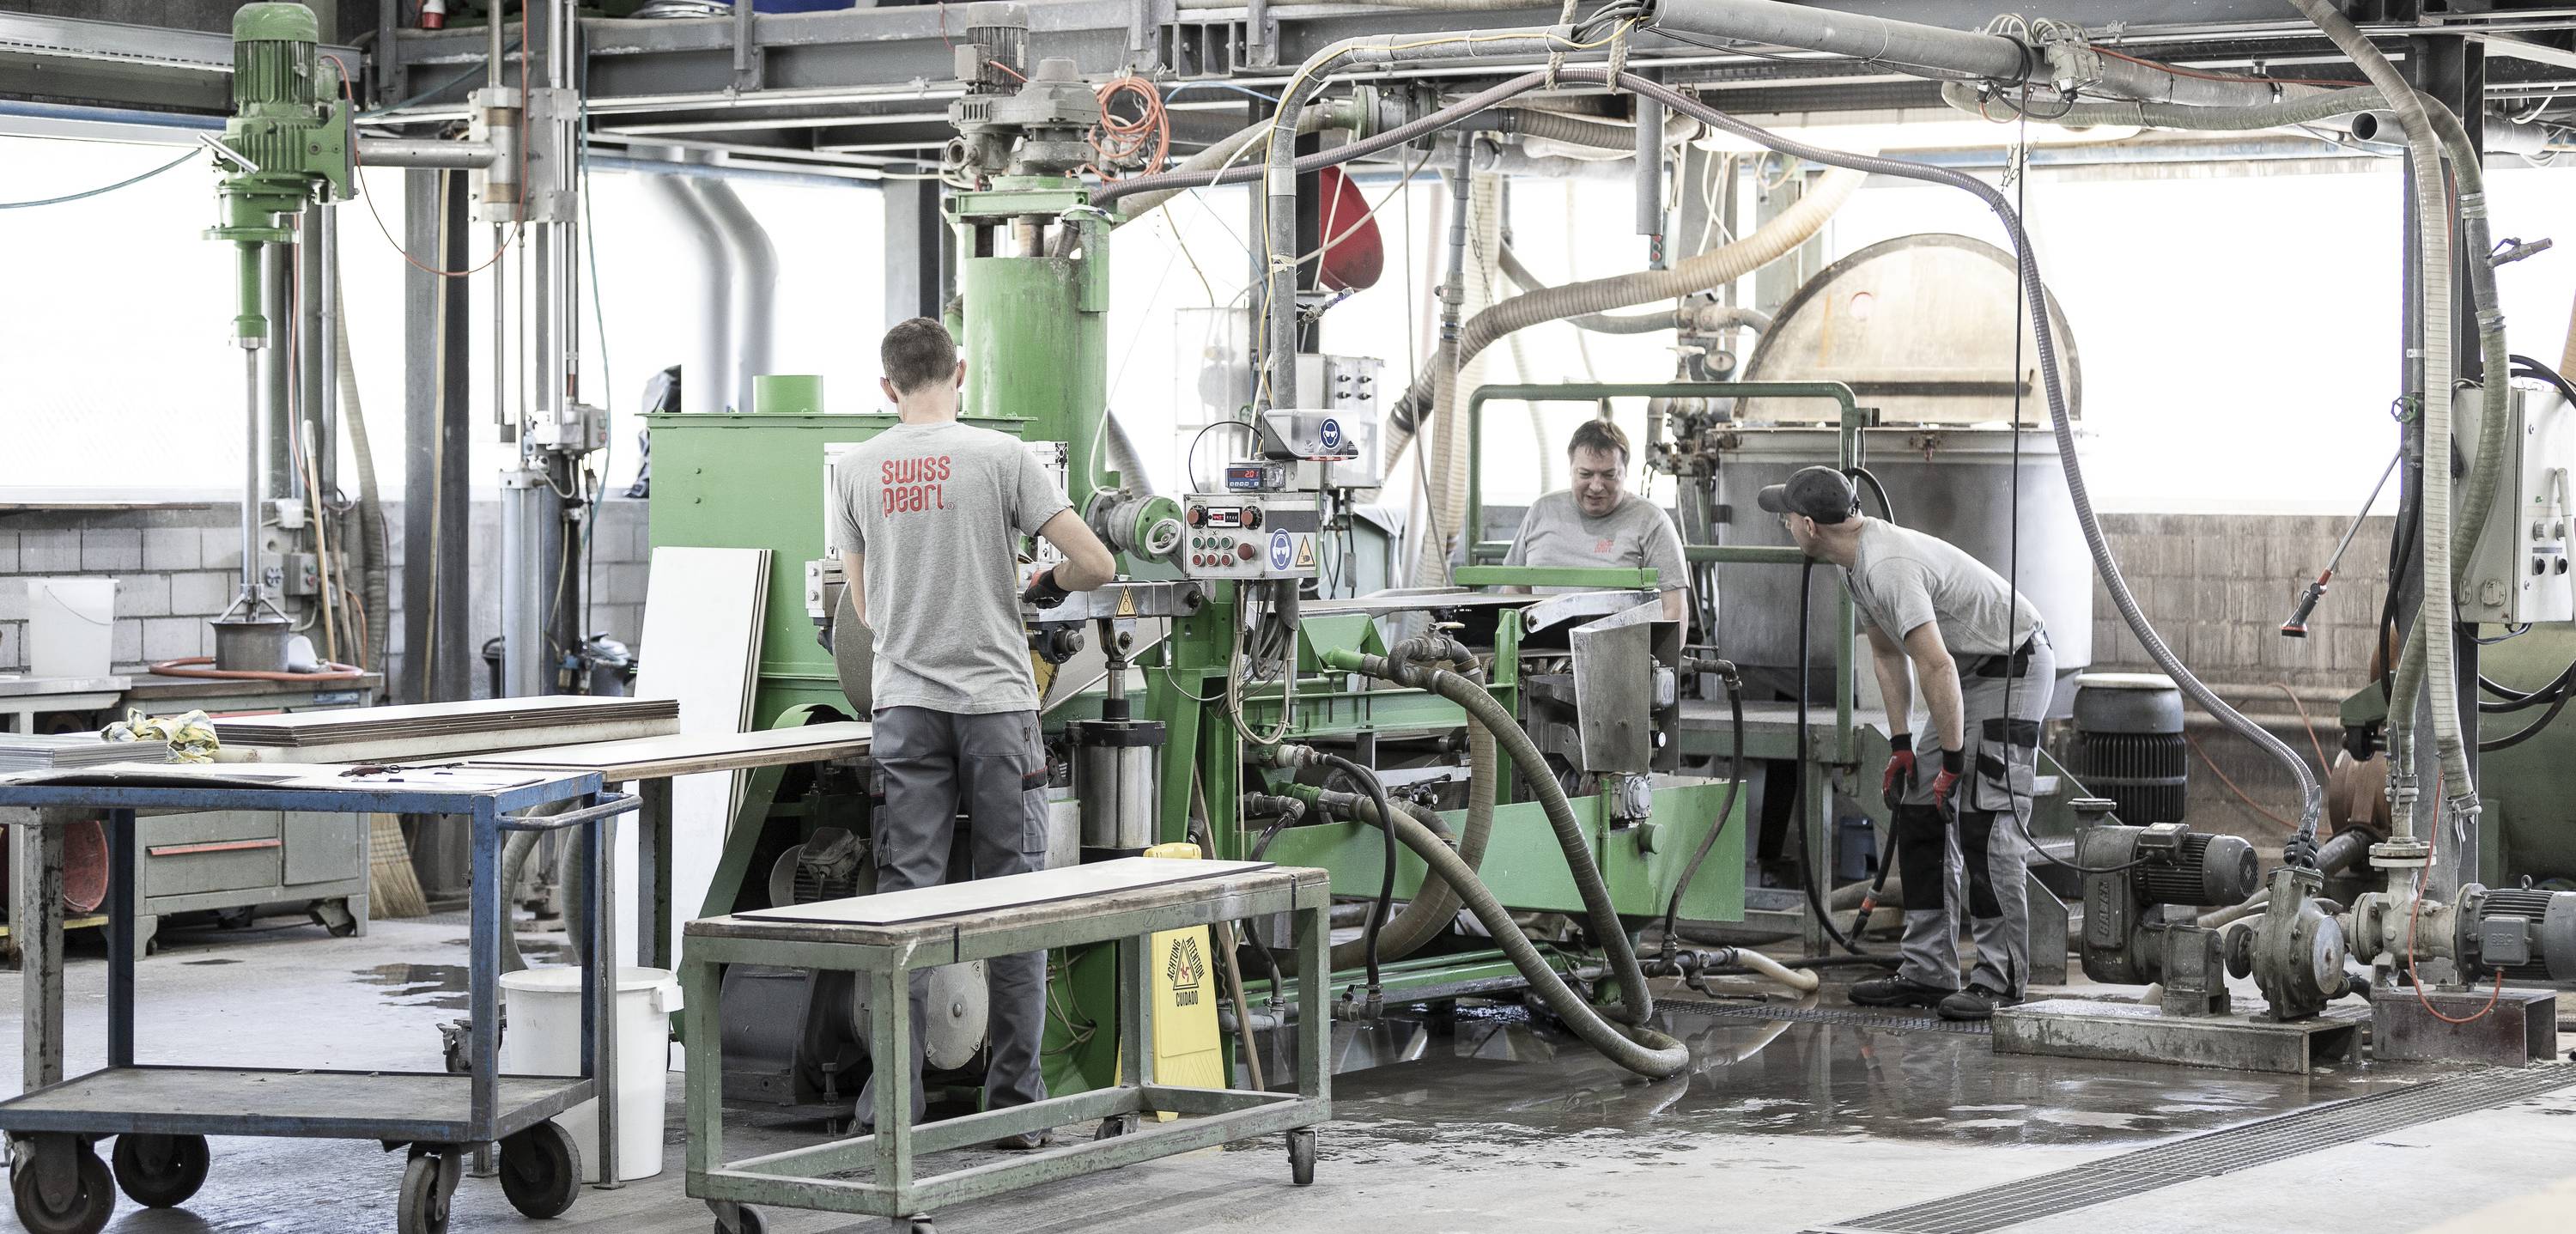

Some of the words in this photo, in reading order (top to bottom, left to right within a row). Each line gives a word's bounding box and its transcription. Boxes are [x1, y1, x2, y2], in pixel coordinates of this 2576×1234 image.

[881, 455, 951, 485] swiss
[882, 483, 945, 518] pearl
[1166, 938, 1182, 982] ACHTUNG
[1185, 936, 1205, 980] ATTENTION
[1176, 990, 1199, 1007] CUIDADO
